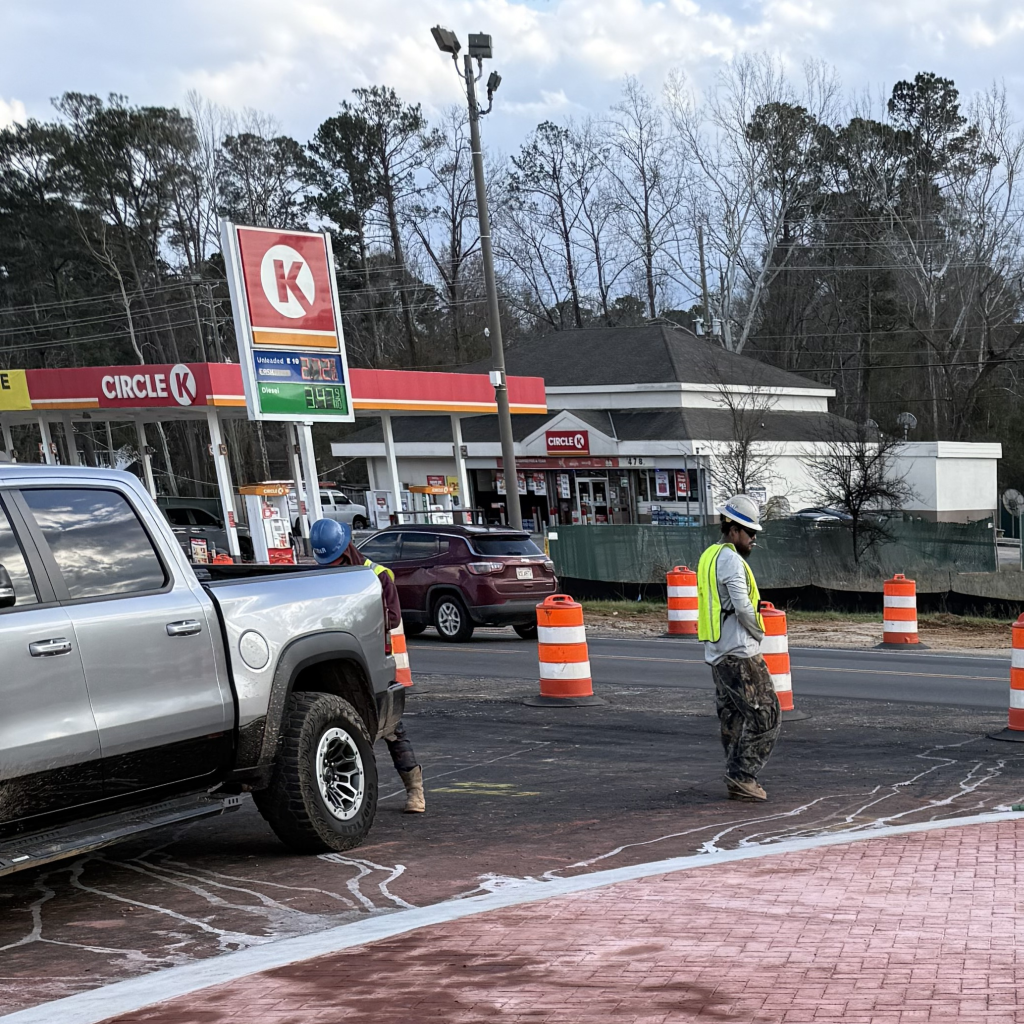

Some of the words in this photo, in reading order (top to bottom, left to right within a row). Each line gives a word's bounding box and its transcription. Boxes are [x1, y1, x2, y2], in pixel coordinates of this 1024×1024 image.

[270, 256, 314, 315] K
[101, 374, 168, 399] CIRCLE
[172, 368, 196, 404] K
[548, 437, 574, 446] CIRCLE
[575, 435, 584, 448] K
